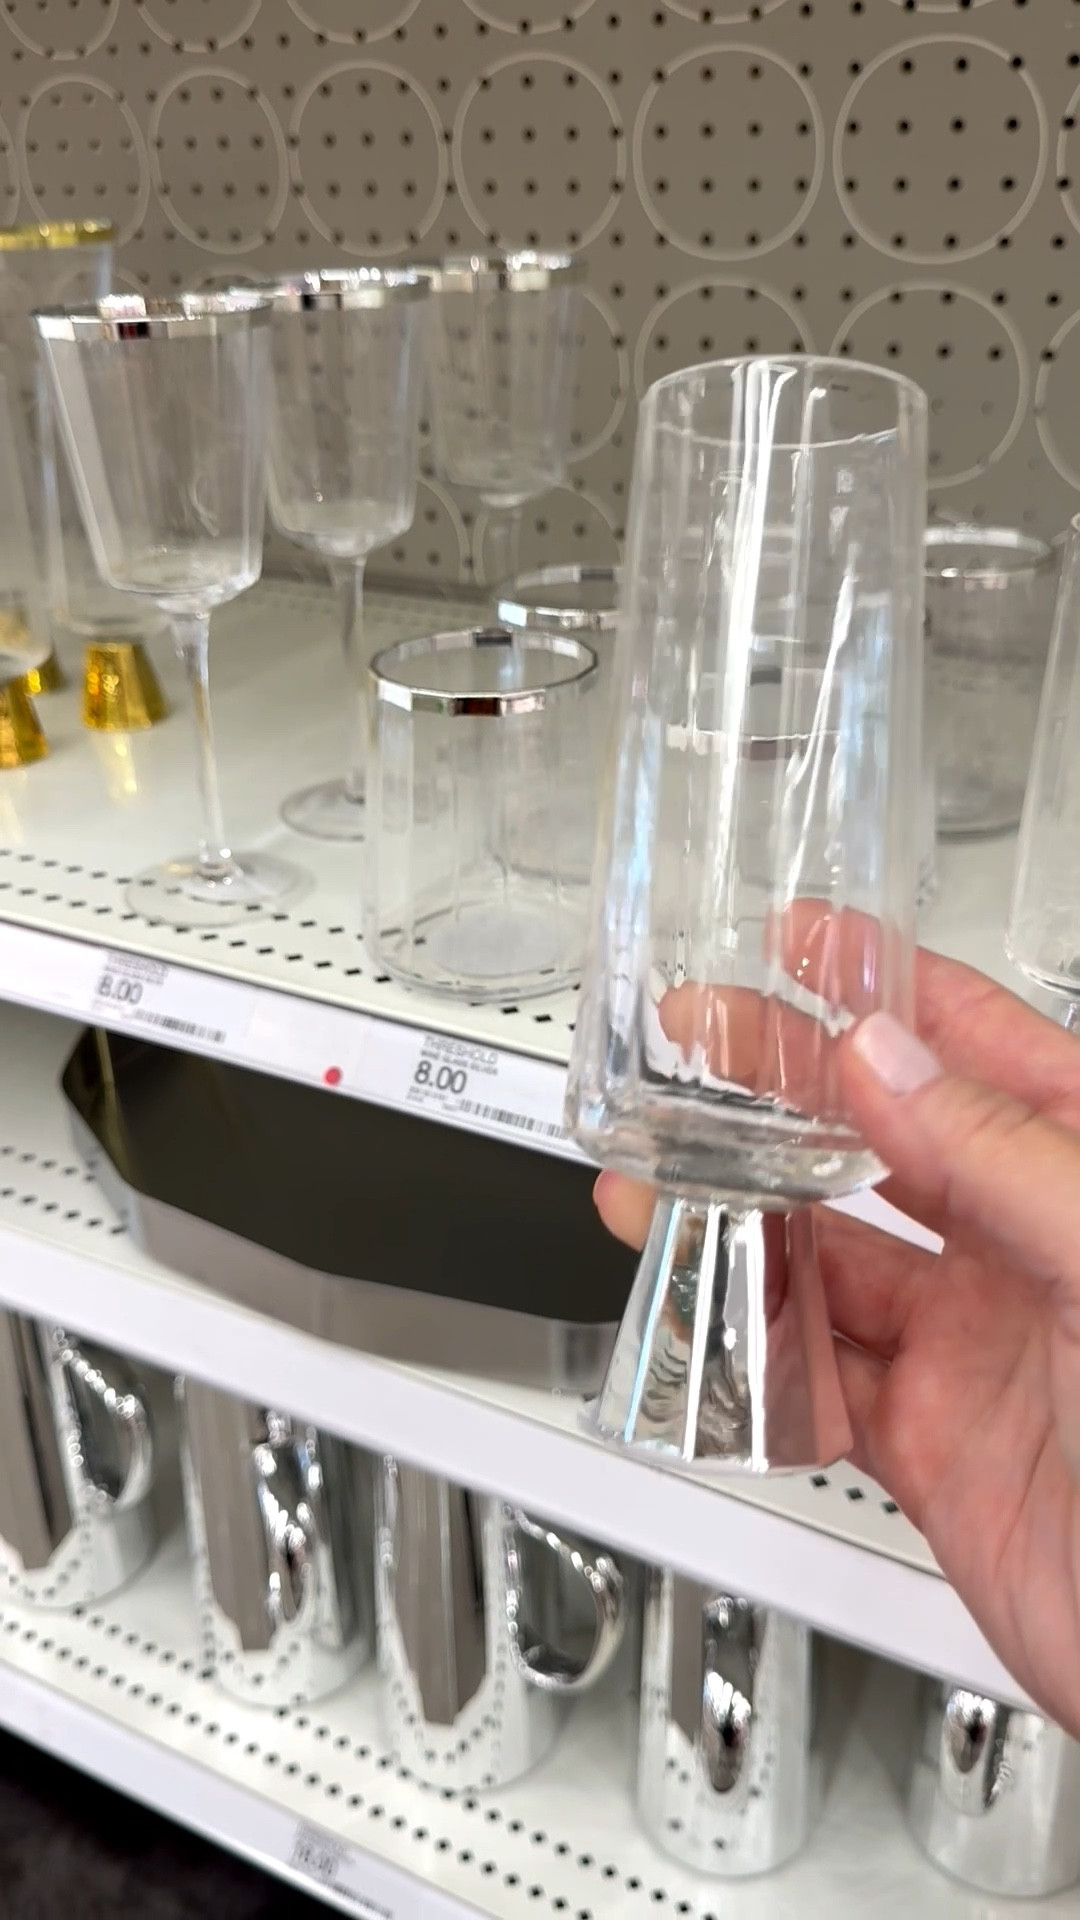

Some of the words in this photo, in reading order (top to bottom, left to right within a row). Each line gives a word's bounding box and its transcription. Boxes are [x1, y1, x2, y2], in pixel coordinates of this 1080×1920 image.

[97, 974, 143, 1005] 8.00
[424, 1035, 499, 1065] THRESHOLD
[414, 1060, 468, 1094] 8.00
